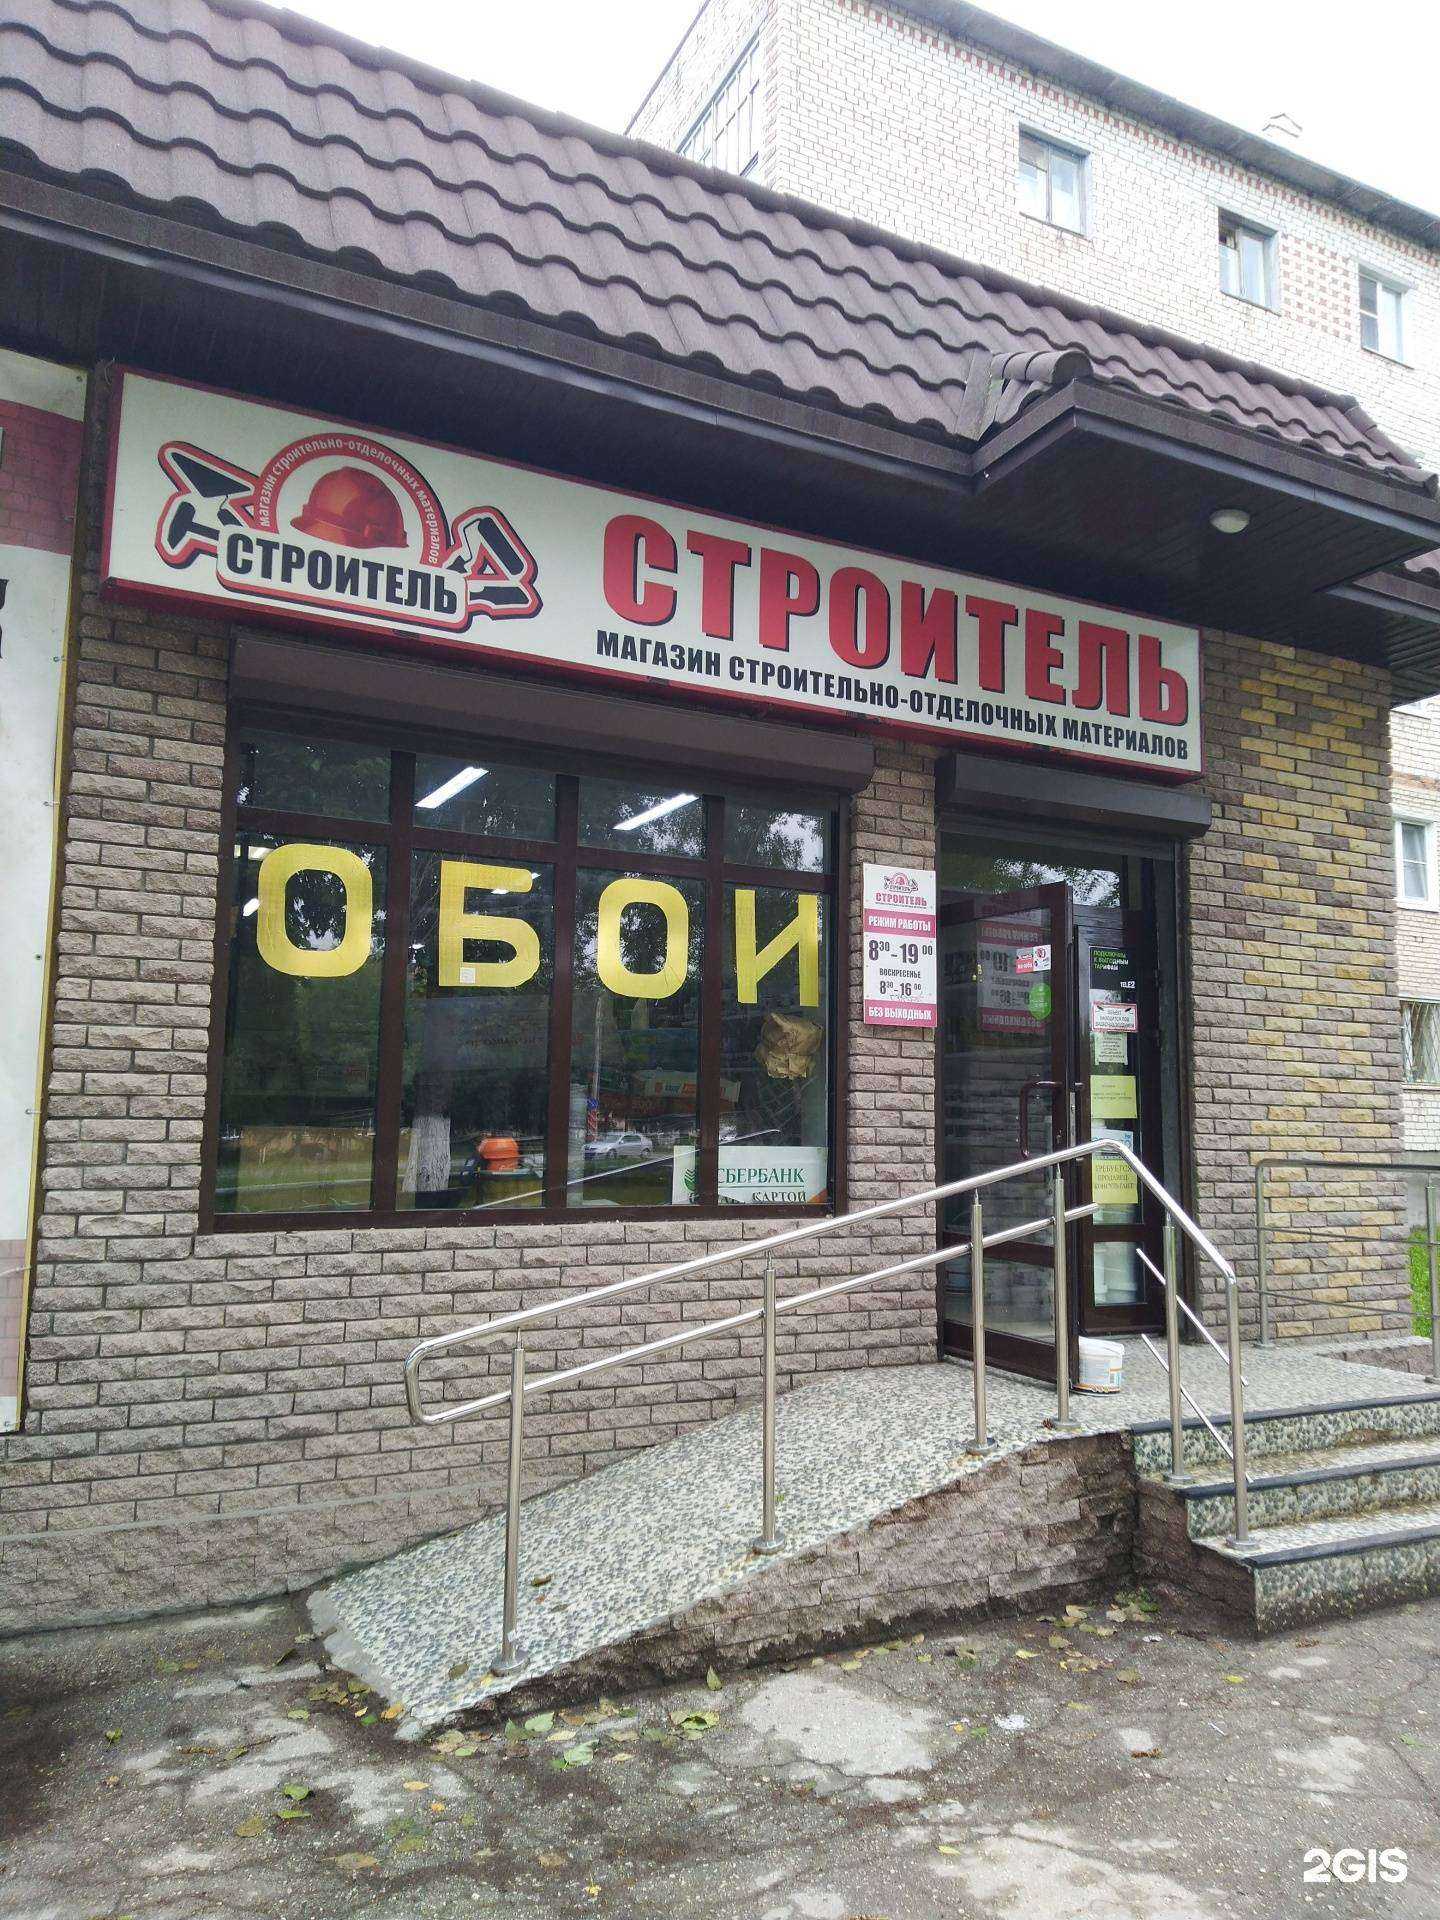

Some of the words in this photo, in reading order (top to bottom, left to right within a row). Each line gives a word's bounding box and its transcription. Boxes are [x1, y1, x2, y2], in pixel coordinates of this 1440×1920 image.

[256, 476, 276, 527] магазин
[275, 439, 419, 490] строительно-отделочных
[416, 489, 441, 564] материалов
[226, 533, 458, 614] СТРОИТЕЛЬ
[603, 514, 1189, 726] СТРОИТЕЛЬ
[597, 629, 722, 678] МАГАЗИН
[729, 655, 1058, 739] СТРОИТЕЛЬНО-ОТДЕЛОЧНЫХ
[1062, 718, 1189, 760] МАТЕРИАЛОВ
[256, 842, 820, 1008] ОБОИ
[868, 915, 897, 929] РЕЖИМ
[898, 918, 931, 932] РАБОТЫ
[875, 892, 928, 907] СТРОИТЕЛЬ
[868, 1006, 884, 1018] БЕЗ
[884, 1007, 932, 1021] ВЫХОДНЫХ
[879, 967, 922, 979] ВОСКРЕСЕНЬЕ
